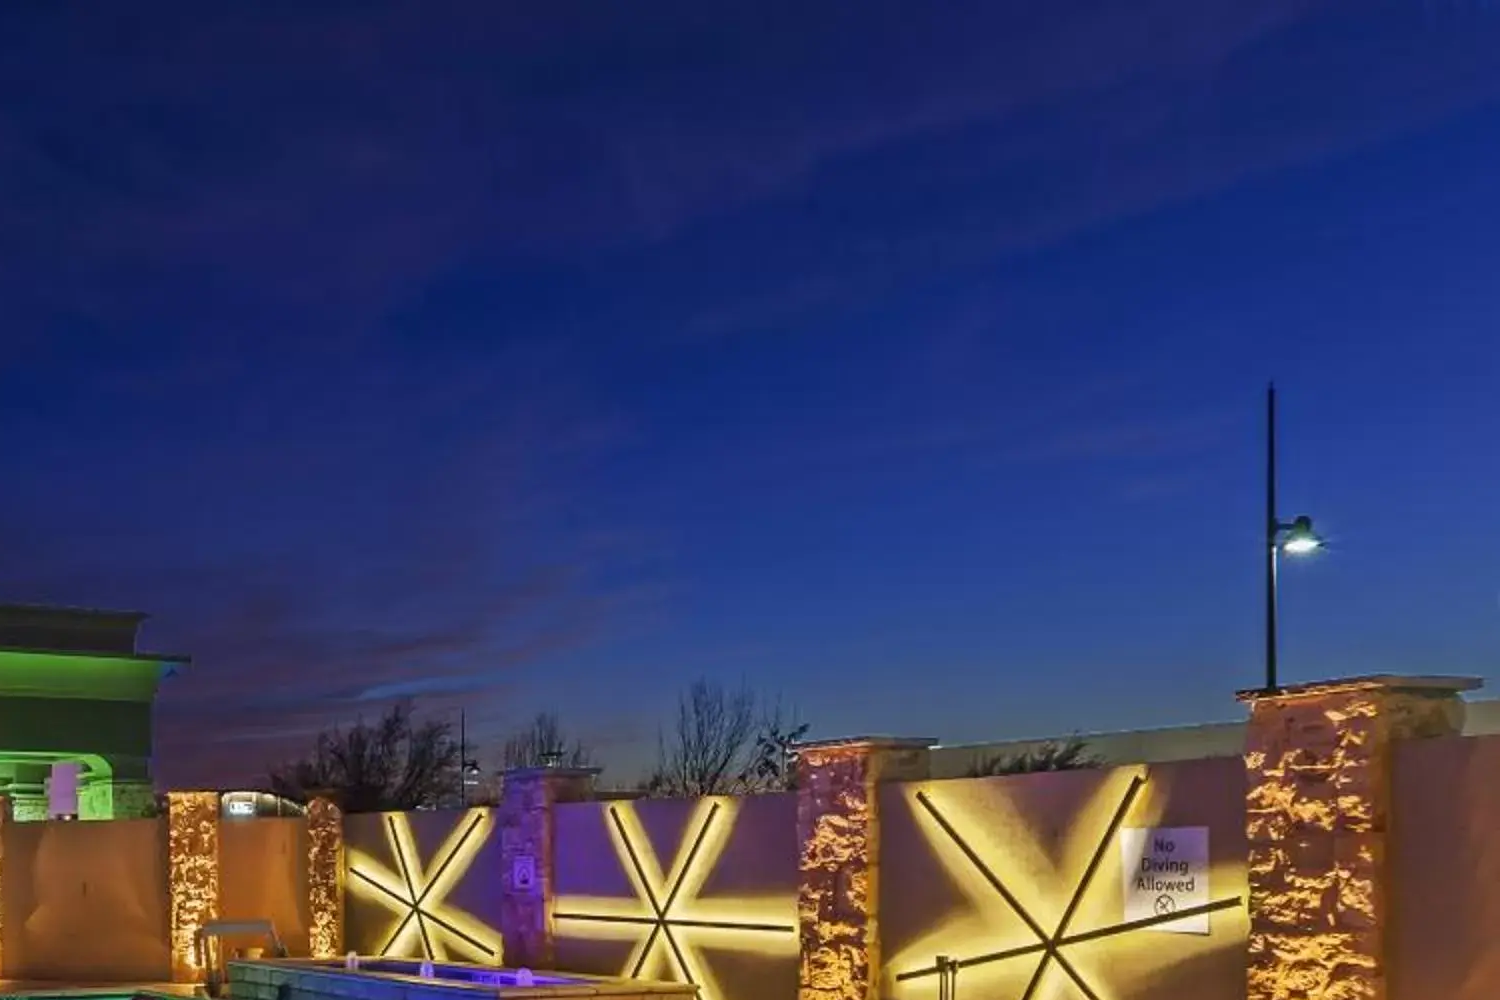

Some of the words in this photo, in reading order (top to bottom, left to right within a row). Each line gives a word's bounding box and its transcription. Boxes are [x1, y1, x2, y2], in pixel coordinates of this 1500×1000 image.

[1154, 838, 1175, 852] No
[1141, 857, 1189, 876] Diving
[1137, 876, 1195, 892] Allowed
